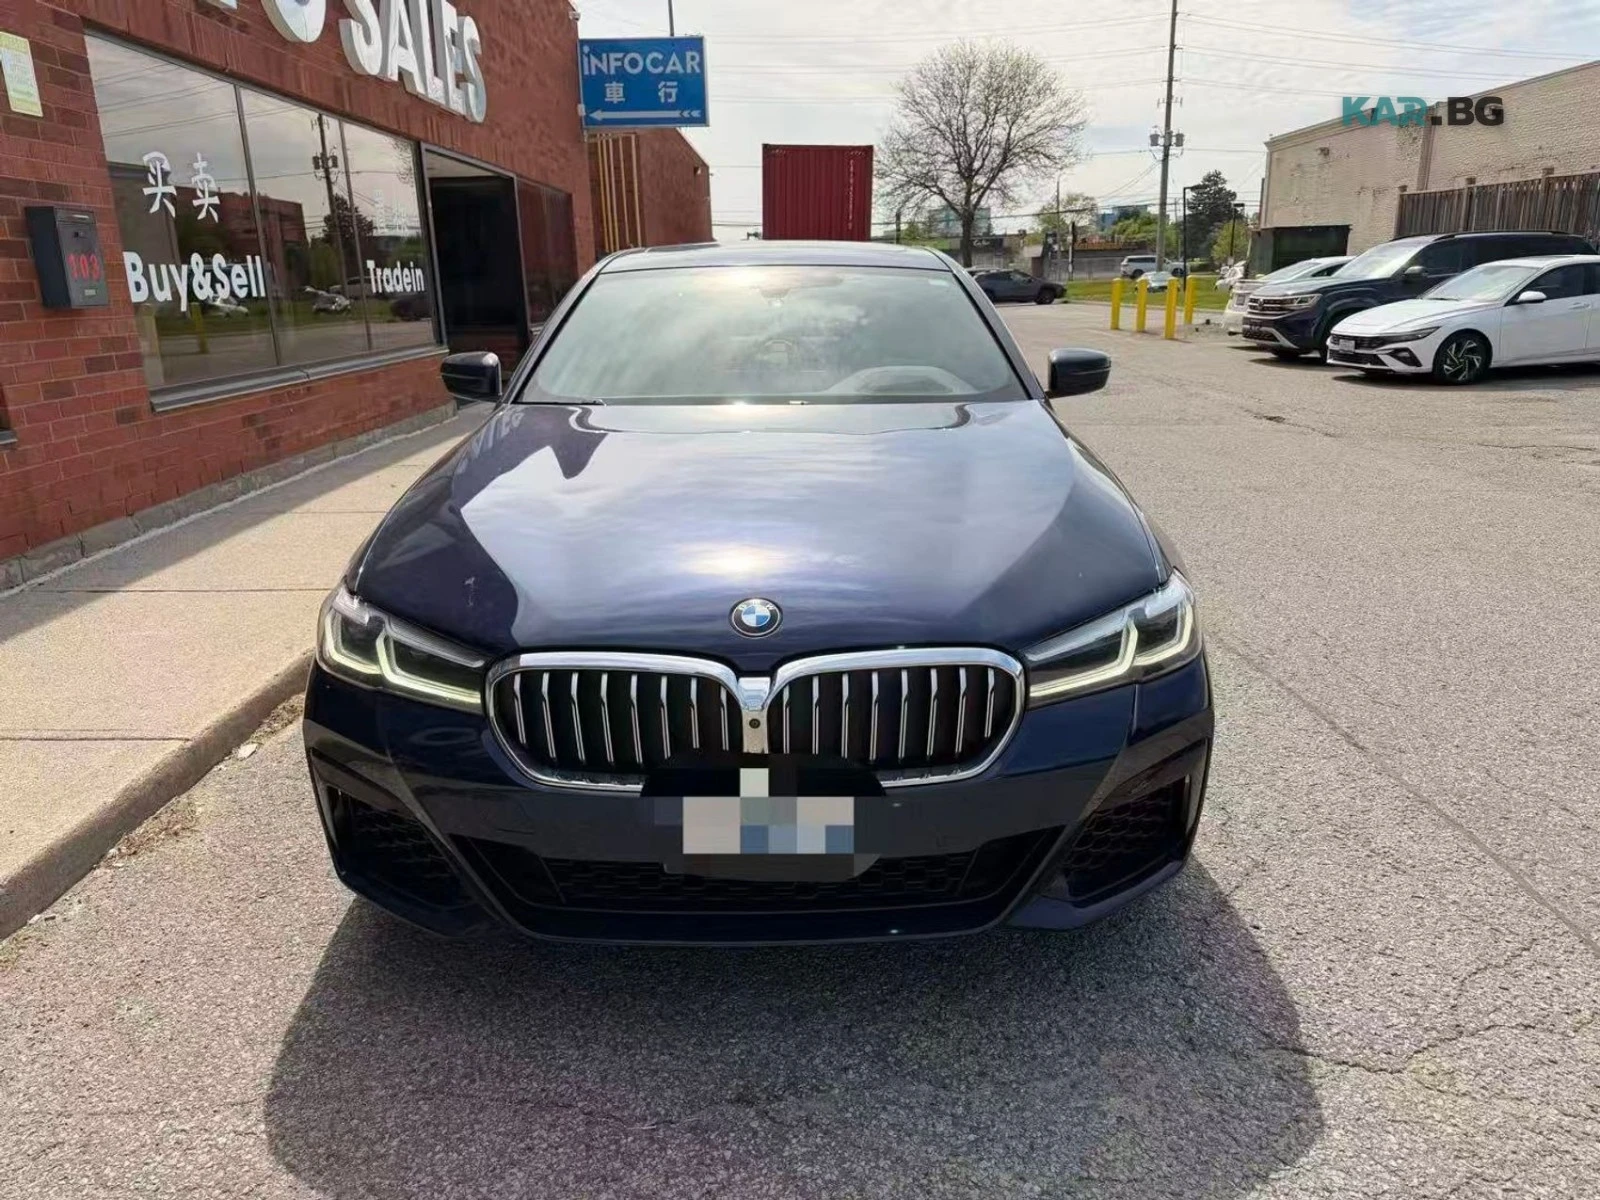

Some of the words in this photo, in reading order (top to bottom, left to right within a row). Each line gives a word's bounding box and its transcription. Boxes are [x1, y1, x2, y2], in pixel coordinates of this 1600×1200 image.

[339, 0, 487, 123] SALES
[603, 81, 679, 104] 車行
[142, 151, 221, 223] 买卖
[122, 251, 266, 312] Buy&Sell
[366, 259, 425, 294] Tradein
